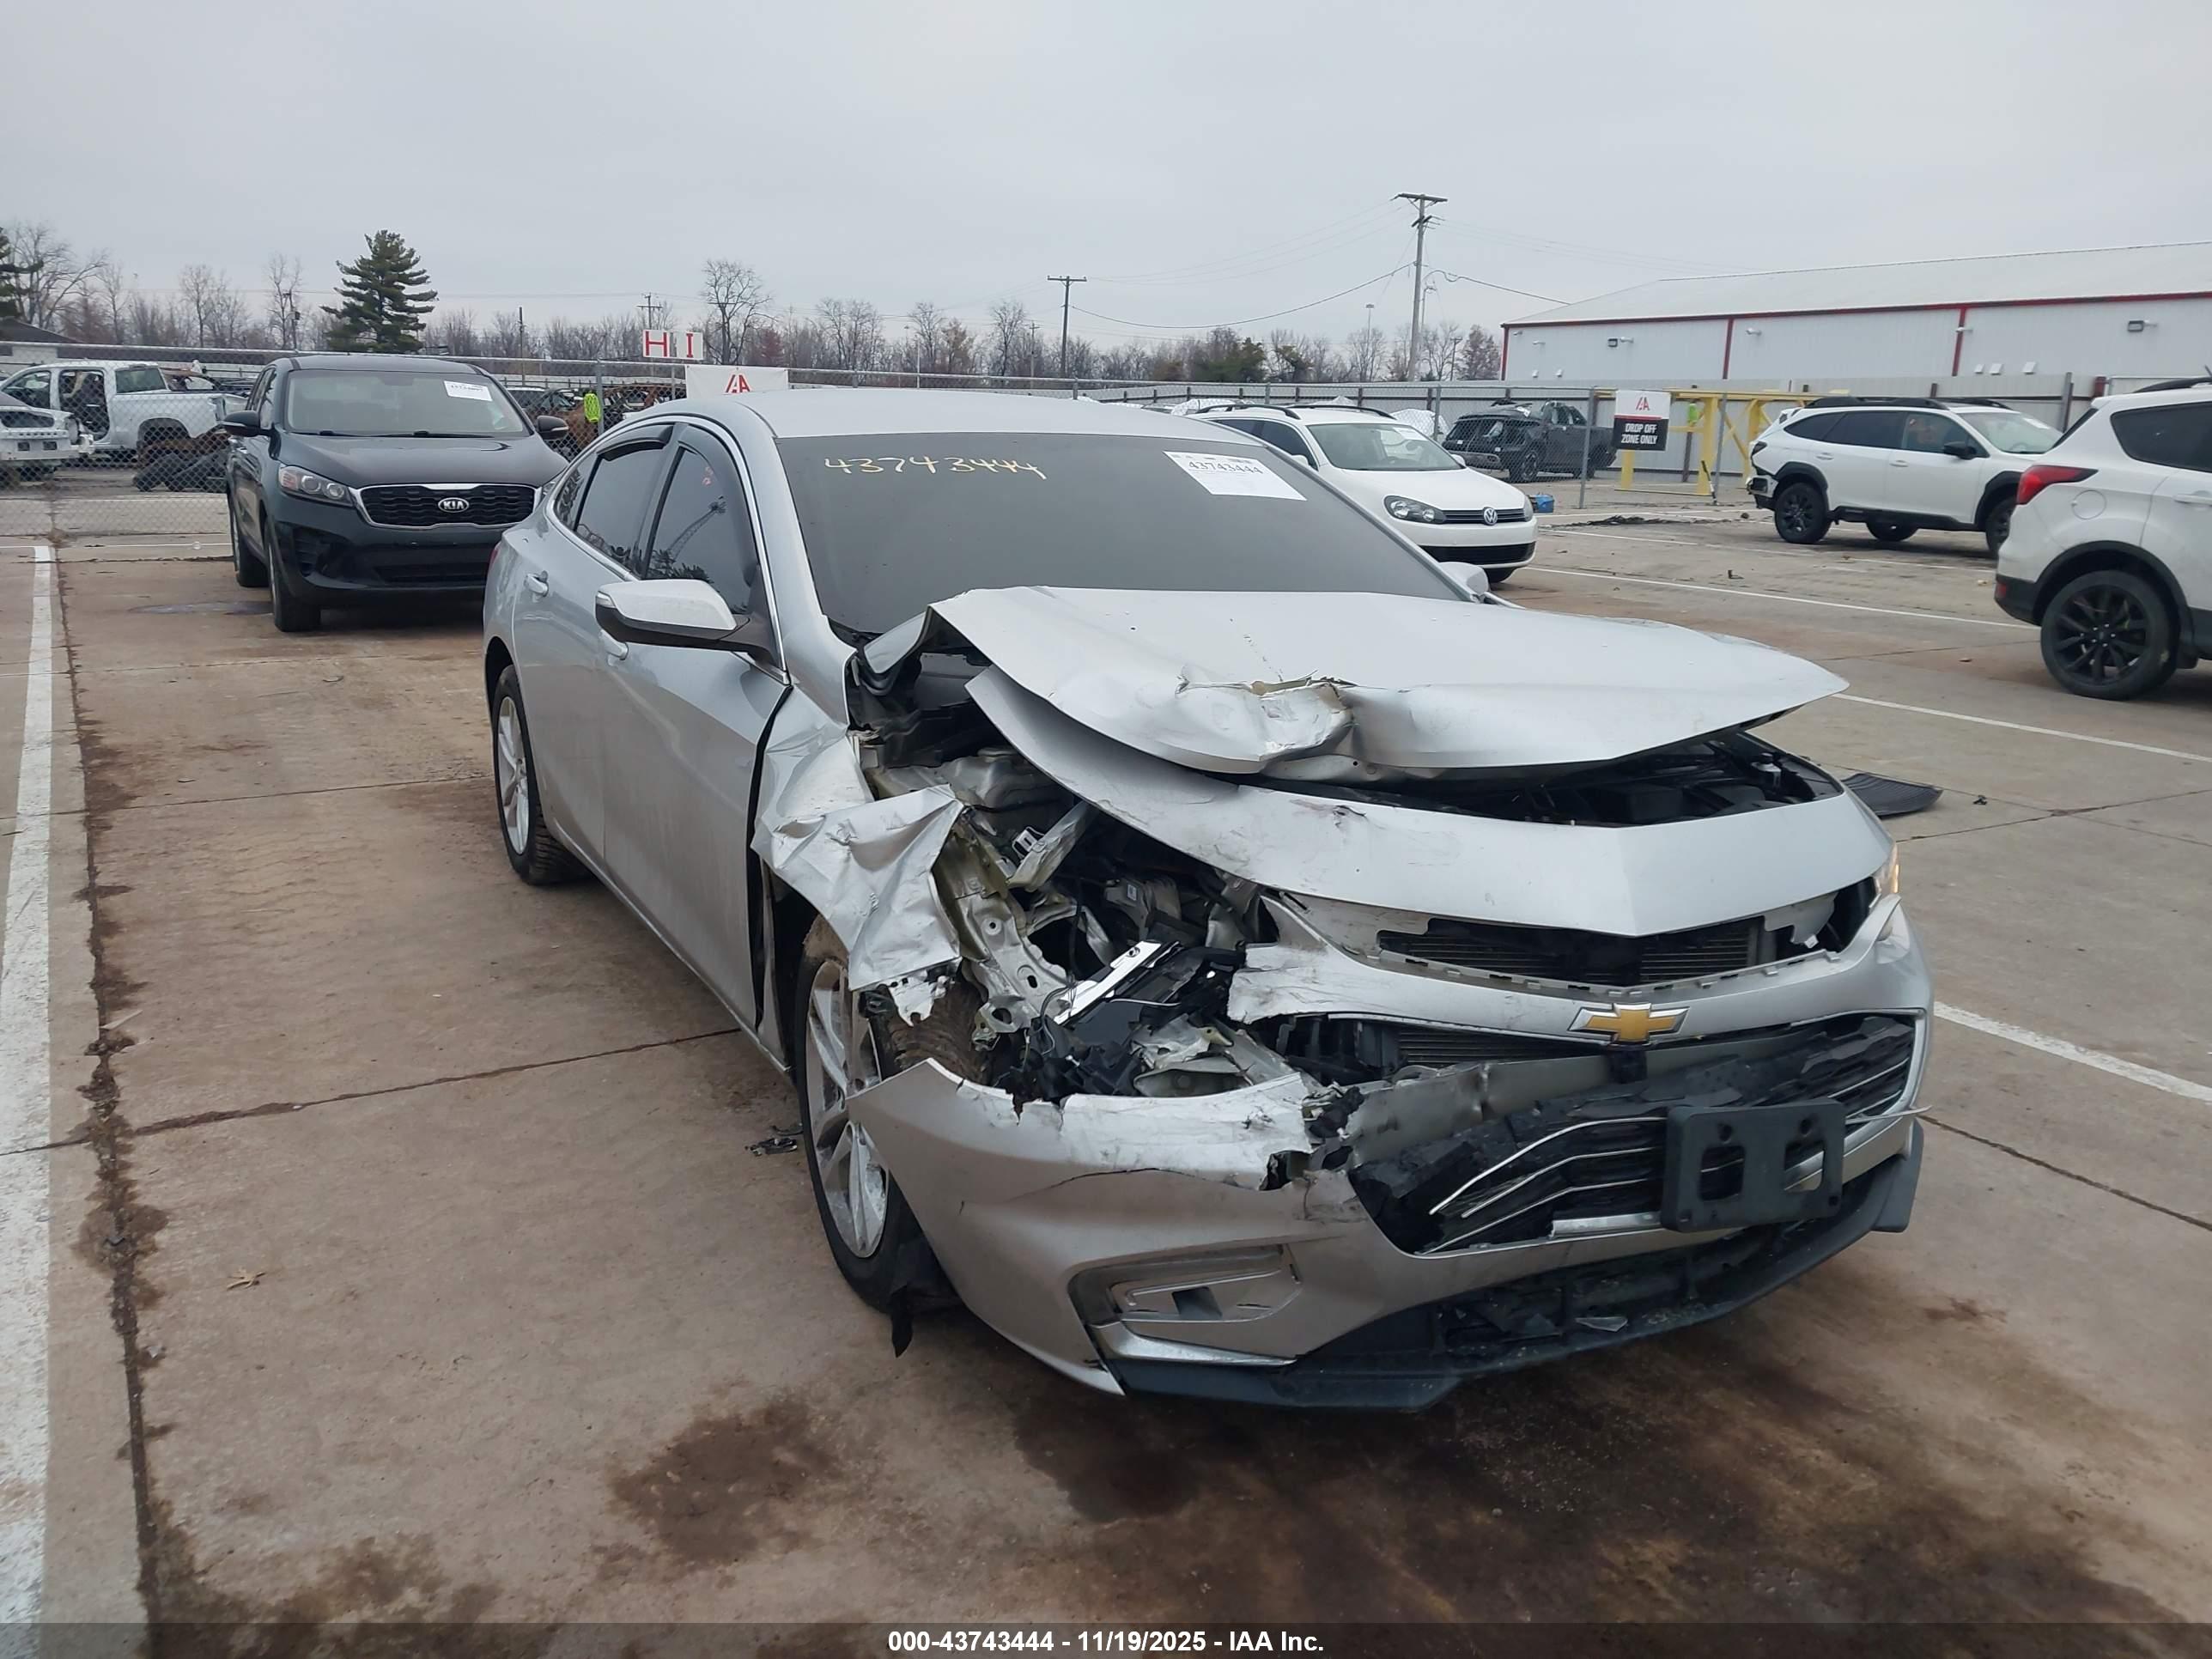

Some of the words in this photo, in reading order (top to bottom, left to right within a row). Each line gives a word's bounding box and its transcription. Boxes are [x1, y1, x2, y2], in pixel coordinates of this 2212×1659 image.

[1625, 423, 1644, 433] DROP
[1644, 423, 1657, 434] OFF
[1621, 434, 1639, 444] ZONE
[1640, 435, 1657, 445] ONLY
[824, 457, 1047, 480] 43743444
[1188, 460, 1263, 474] 43743444
